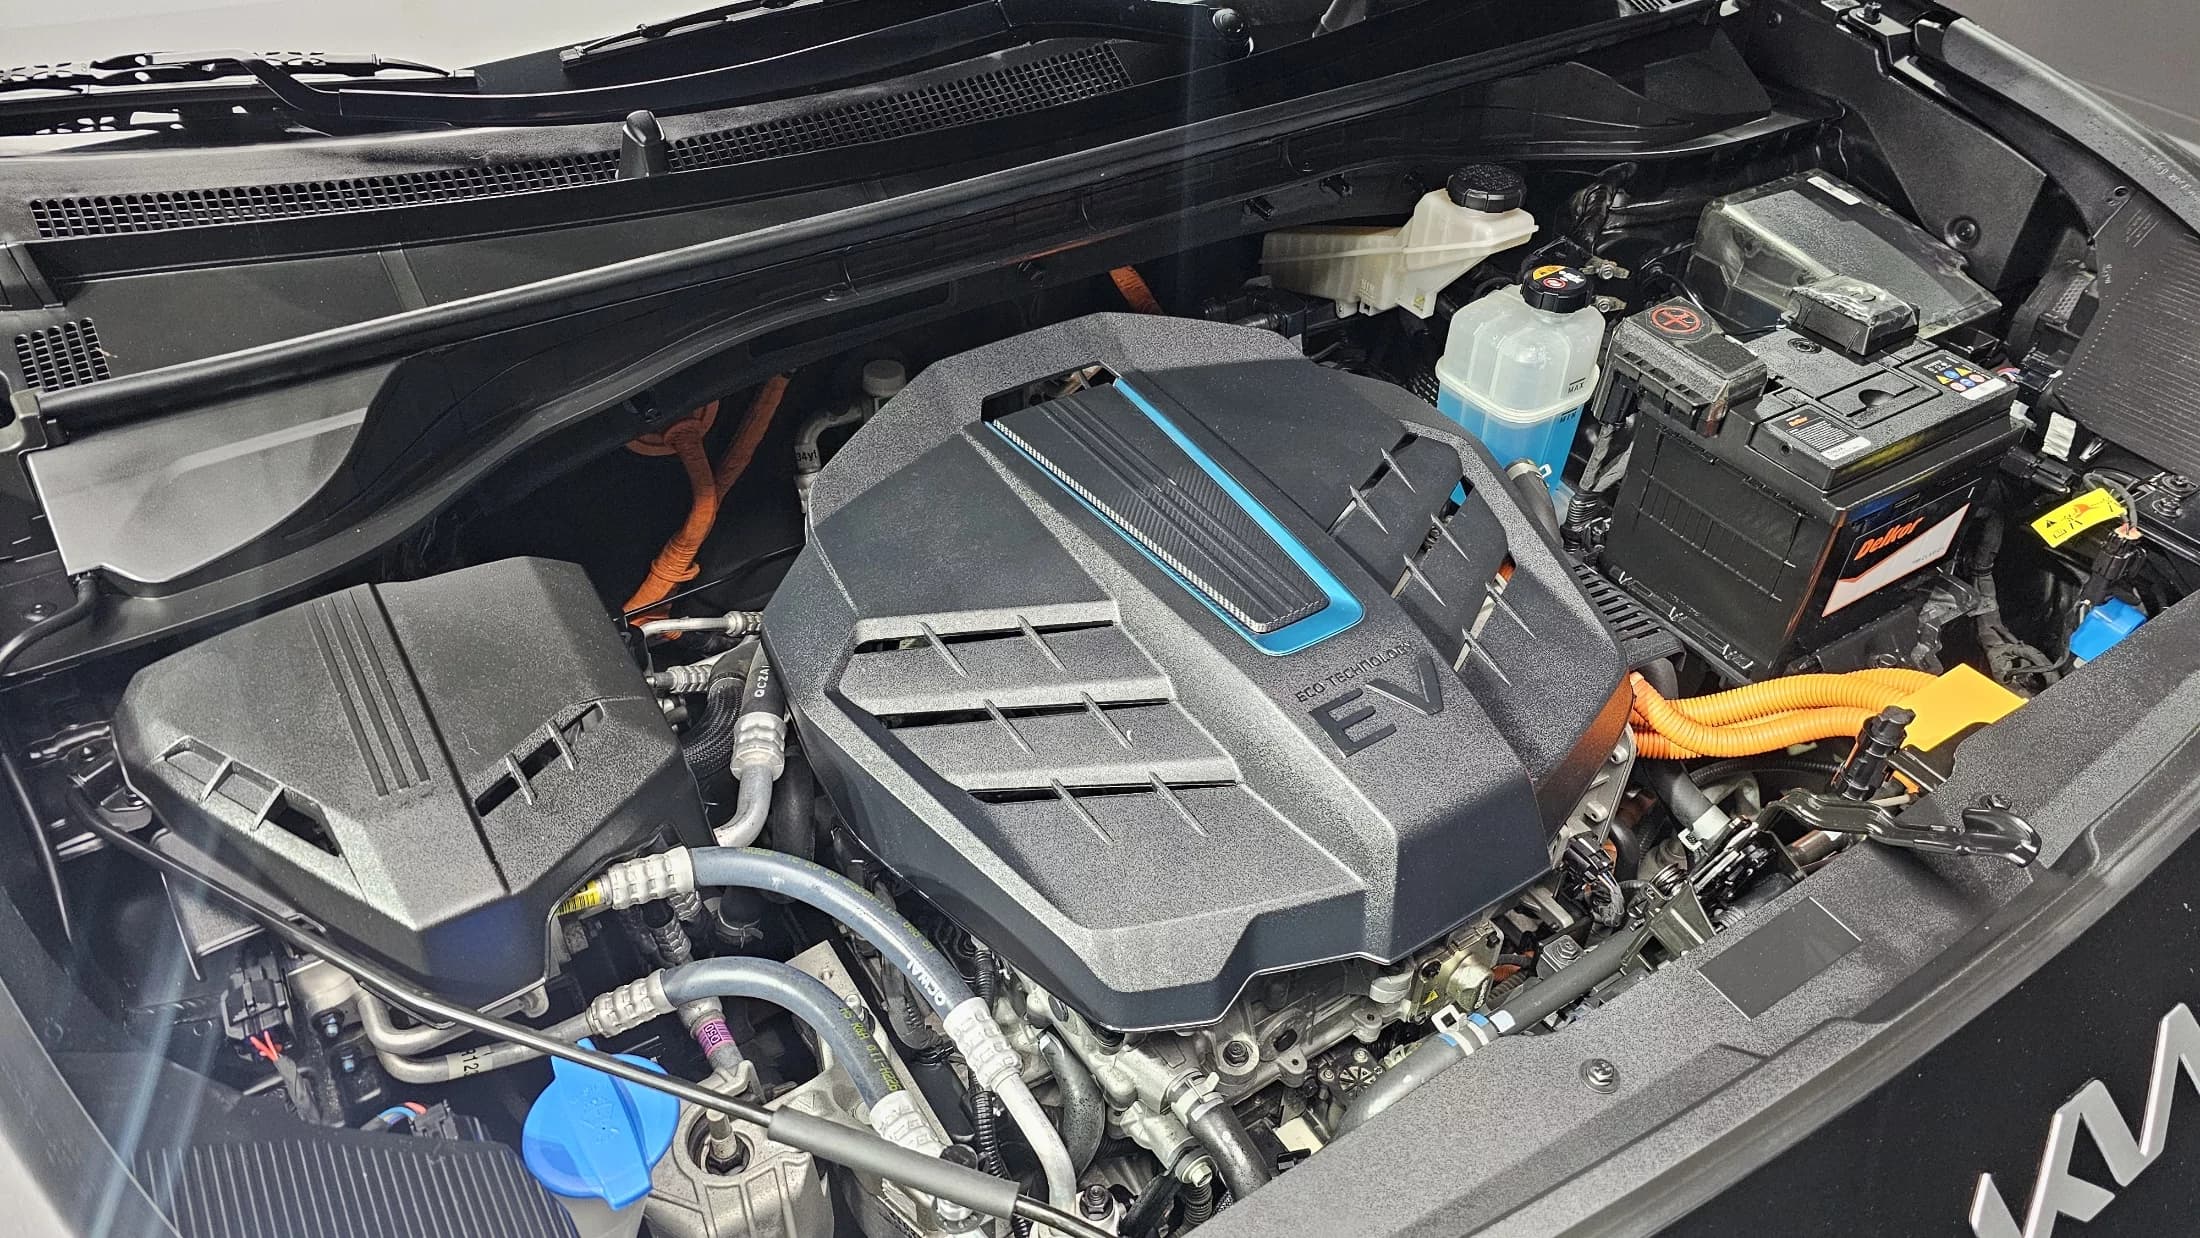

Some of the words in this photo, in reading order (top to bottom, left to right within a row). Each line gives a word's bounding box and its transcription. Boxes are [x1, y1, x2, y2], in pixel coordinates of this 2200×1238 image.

[1568, 382, 1584, 394] MAX
[1560, 411, 1577, 423] MIN
[1854, 516, 1926, 561] Delkor
[1295, 682, 1326, 702] ECO
[1325, 641, 1415, 687] TECHNOLOGY
[1308, 653, 1444, 758] EV
